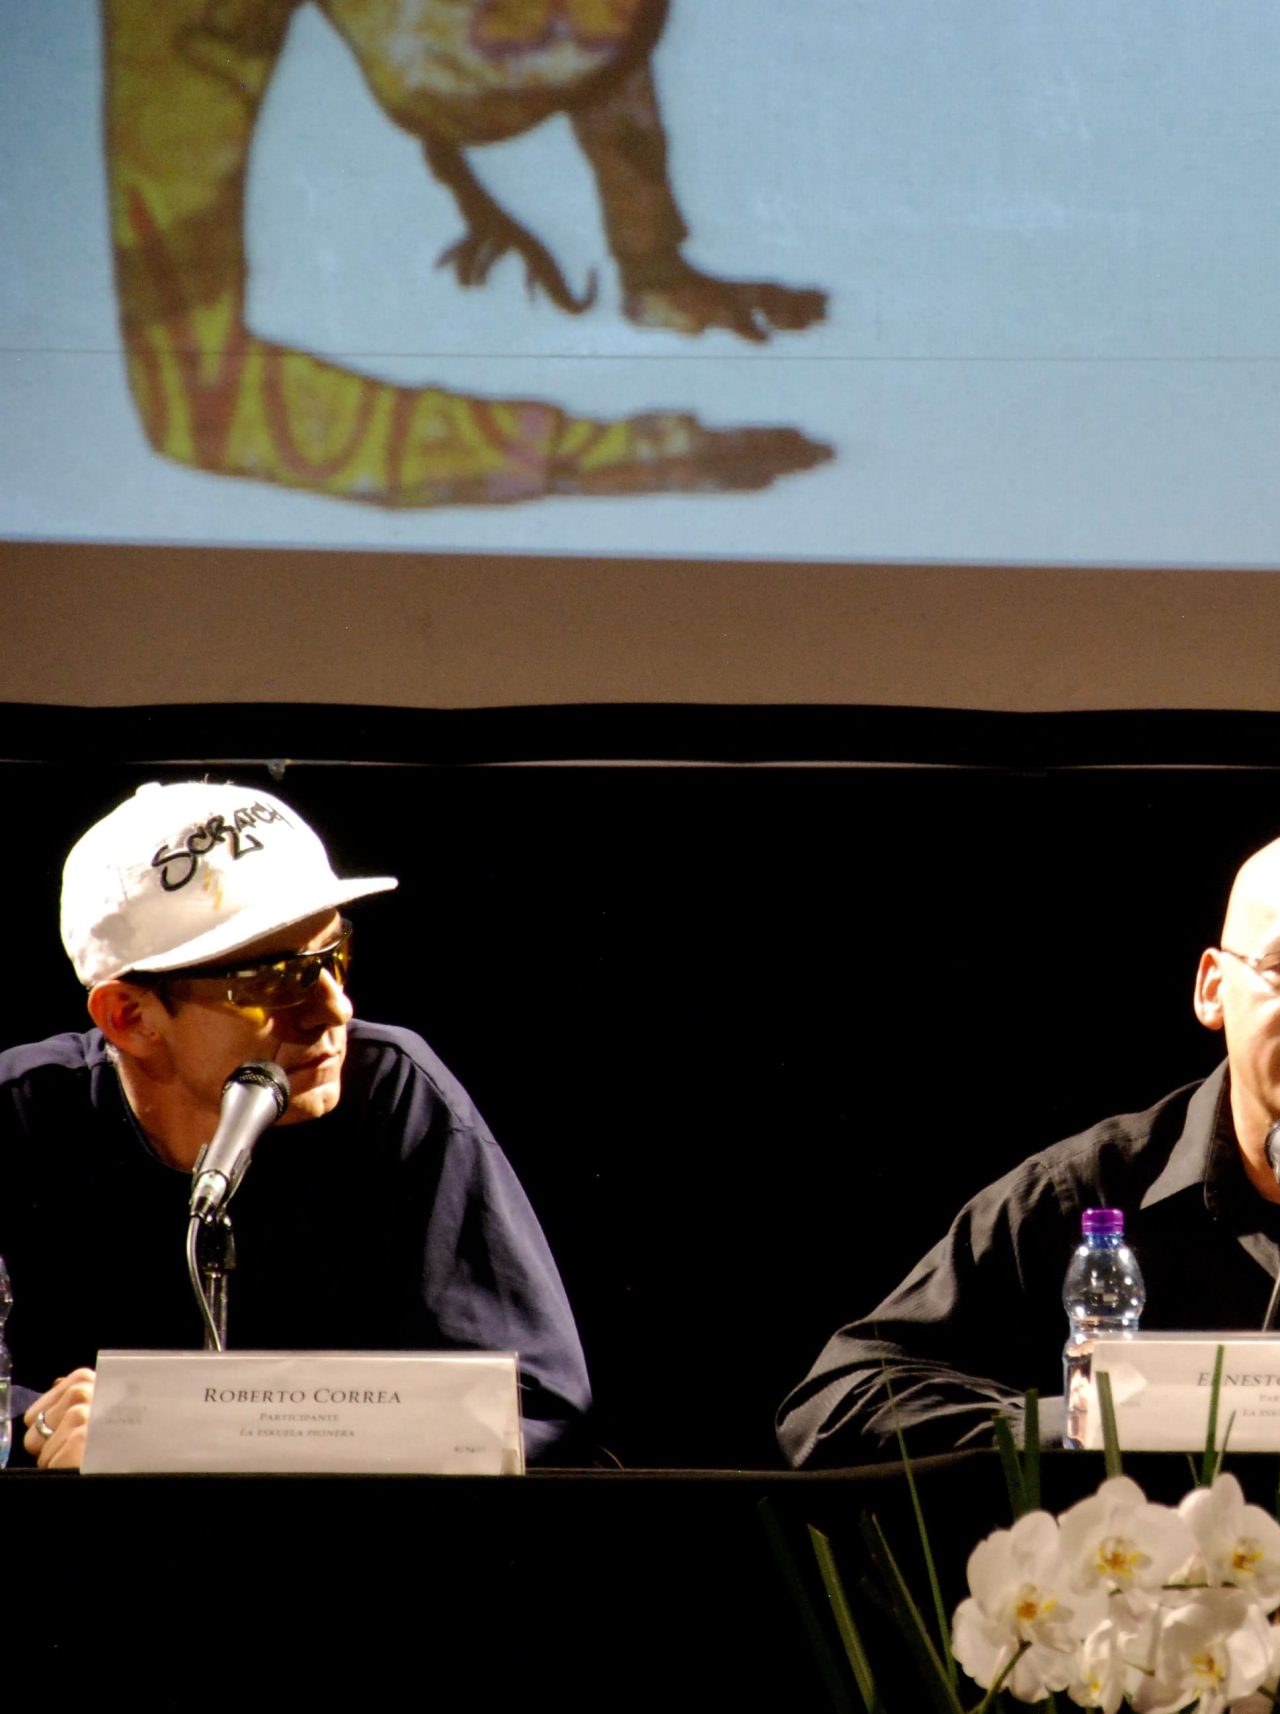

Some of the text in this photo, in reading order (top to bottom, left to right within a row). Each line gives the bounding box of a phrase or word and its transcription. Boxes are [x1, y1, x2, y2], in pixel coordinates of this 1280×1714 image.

[204, 1387, 401, 1404] ROBERTO CORREA
[259, 1412, 339, 1422] PARTICIPANTE
